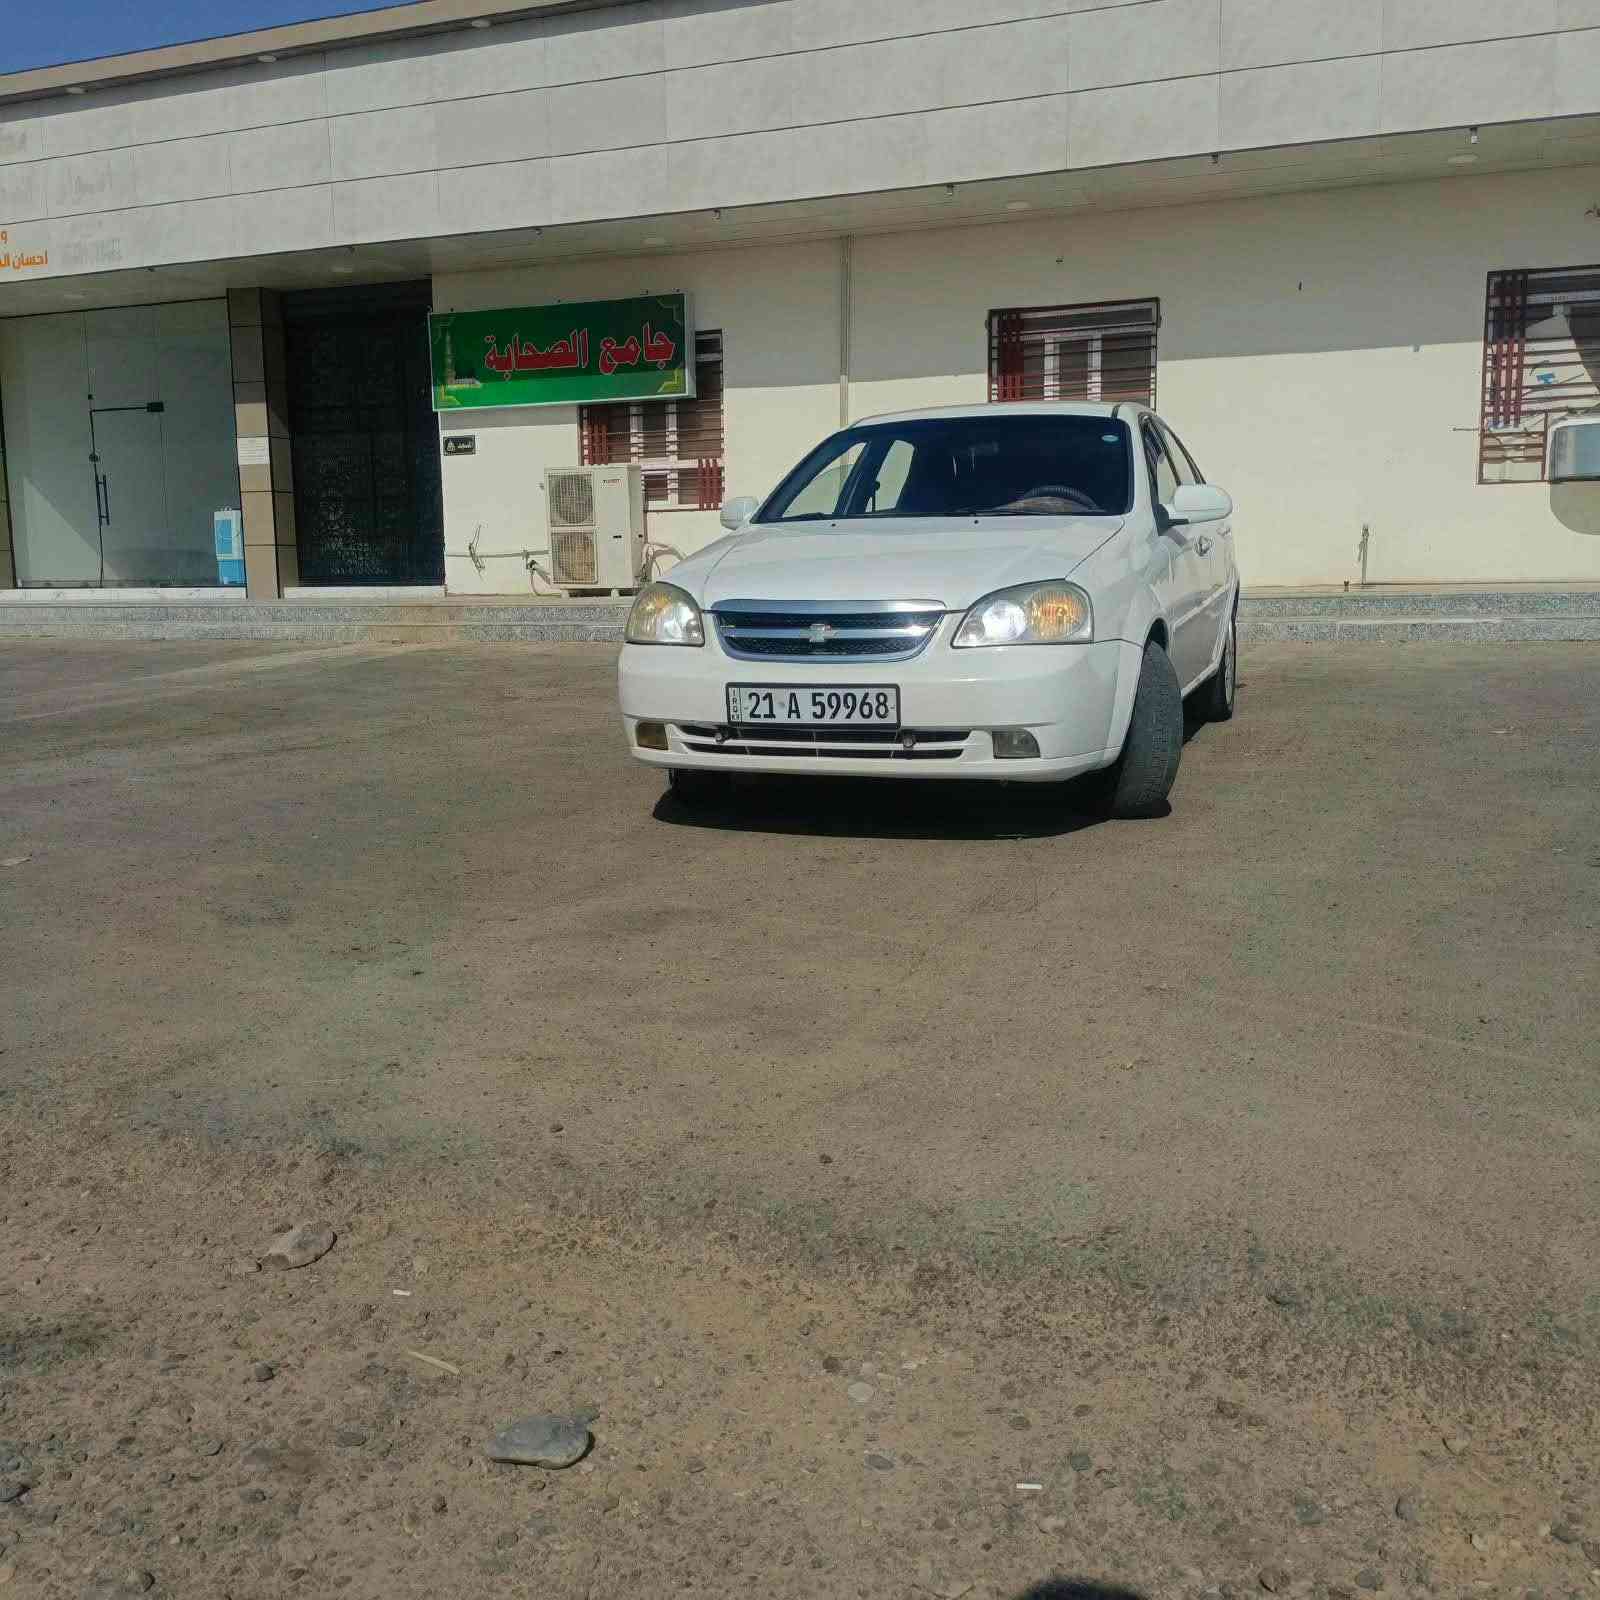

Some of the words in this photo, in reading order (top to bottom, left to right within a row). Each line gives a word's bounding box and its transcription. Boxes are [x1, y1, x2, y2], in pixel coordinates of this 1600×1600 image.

[484, 327, 589, 381] الصحابة
[599, 321, 676, 376] جامع
[748, 692, 776, 719] 21
[787, 692, 801, 719] A
[811, 692, 889, 720] 59968
